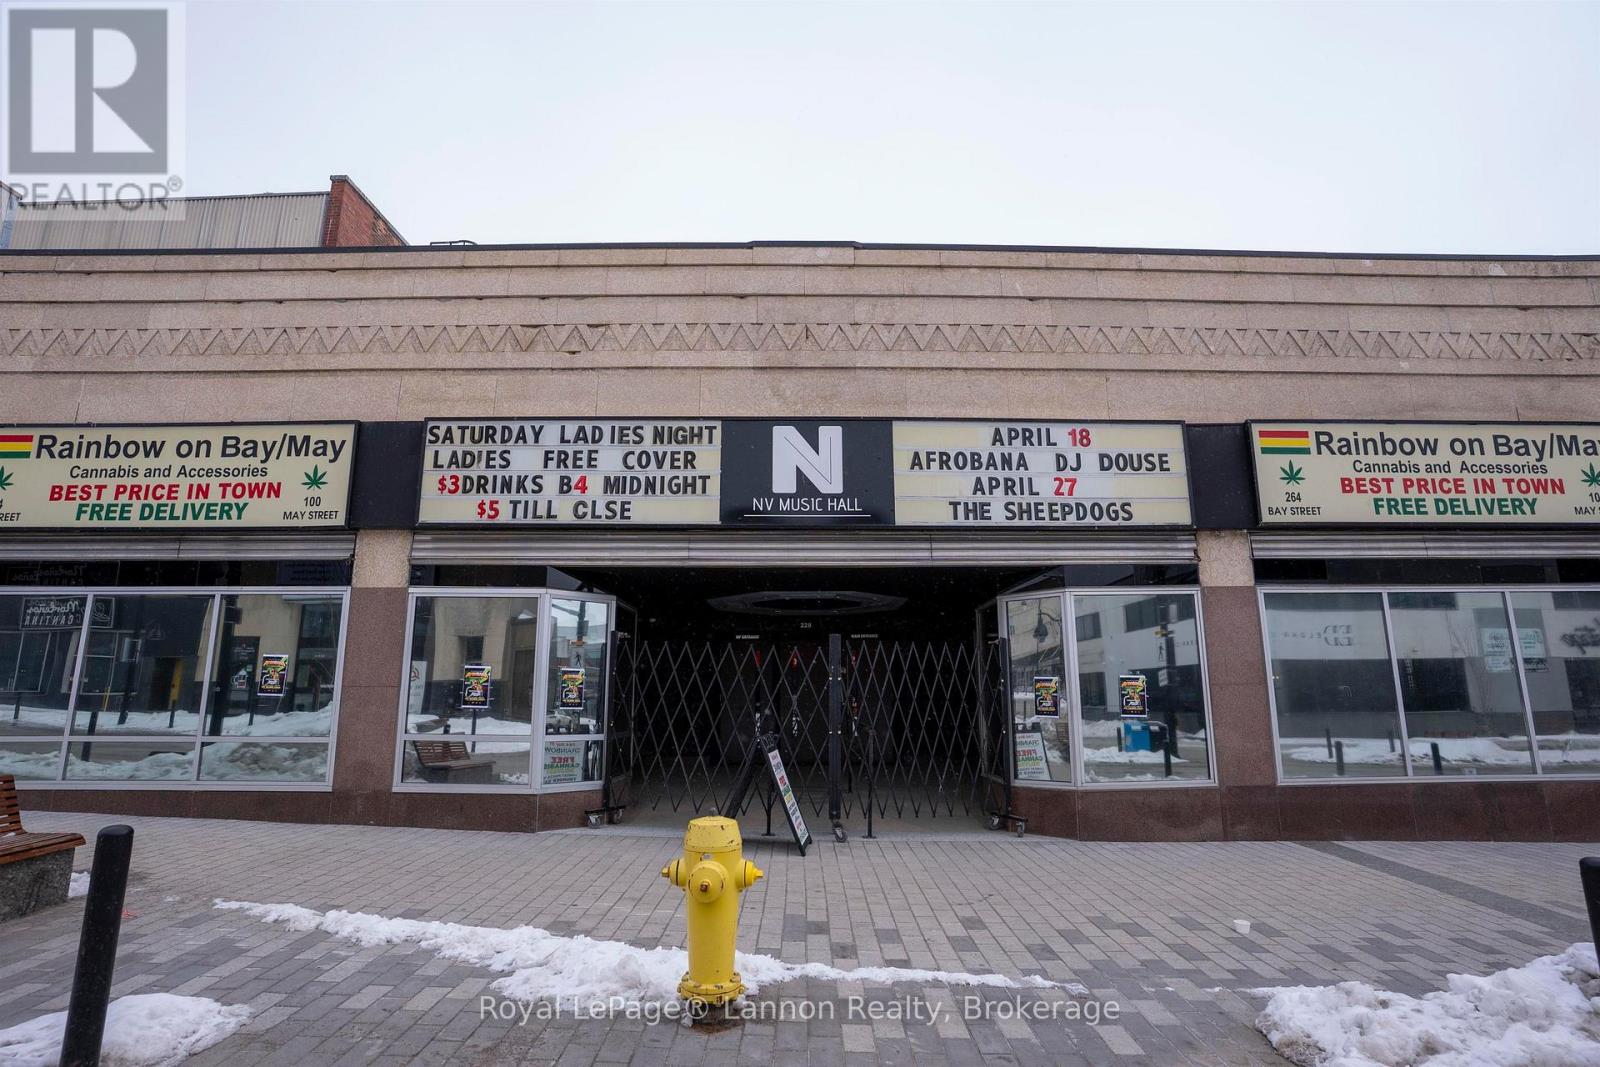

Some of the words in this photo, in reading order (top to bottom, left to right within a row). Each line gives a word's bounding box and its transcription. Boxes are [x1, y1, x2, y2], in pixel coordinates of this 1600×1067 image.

[428, 425, 544, 444] SATURDAY
[559, 425, 644, 444] LADIES
[652, 426, 717, 444] NIGHT
[991, 428, 1057, 447] APRIL
[1068, 428, 1091, 448] 18
[36, 434, 165, 459] Rainbow
[176, 441, 211, 459] on
[221, 432, 346, 463] Bay/May
[1314, 431, 1439, 456] Rainbow
[1450, 438, 1484, 456] on
[1492, 433, 1600, 462] Bay/Ma
[433, 450, 511, 469] LADIES
[543, 450, 598, 469] FREE
[622, 450, 696, 469] COVER
[910, 451, 1028, 471] AFROBANA
[1056, 452, 1082, 472] DJ
[1100, 452, 1170, 472] DOUSE
[1352, 459, 1420, 474] Cannabis
[1425, 460, 1451, 474] and
[1460, 461, 1548, 474] Accessories
[70, 465, 139, 479] Cannabis
[144, 465, 171, 478] and
[177, 465, 268, 478] Accessories
[49, 484, 107, 501] BEST
[114, 484, 179, 500] PRICE
[187, 483, 209, 499] IN
[218, 482, 282, 499] TOWN
[438, 475, 544, 494] $3DRINKS
[558, 476, 588, 494] B4
[603, 476, 710, 494] MIDNIGHT
[972, 477, 1039, 496] APRIL
[1053, 477, 1077, 496] 27
[1340, 478, 1394, 494] BEST
[1402, 478, 1466, 494] PRICE
[1473, 478, 1495, 494] IN
[1502, 478, 1565, 494] TOWN
[303, 497, 321, 507] 100
[753, 498, 773, 511] NV
[780, 498, 823, 511] MUSIC
[828, 498, 862, 511] HALL
[1285, 492, 1301, 502] 264
[76, 504, 133, 520] FREE
[139, 502, 249, 520] DELIVERY
[283, 511, 304, 520] MAY
[308, 510, 339, 519] STREET
[477, 501, 499, 519] $5
[509, 501, 557, 519] TILL
[573, 501, 631, 520] CLSE
[949, 501, 992, 521] THE
[1005, 501, 1133, 521] SHEEPDOGS
[1268, 506, 1288, 516] BAY
[1290, 507, 1321, 516] STREET
[1373, 498, 1429, 515] FREE
[1435, 498, 1538, 515] DELIVERY
[1574, 506, 1596, 515] MAY
